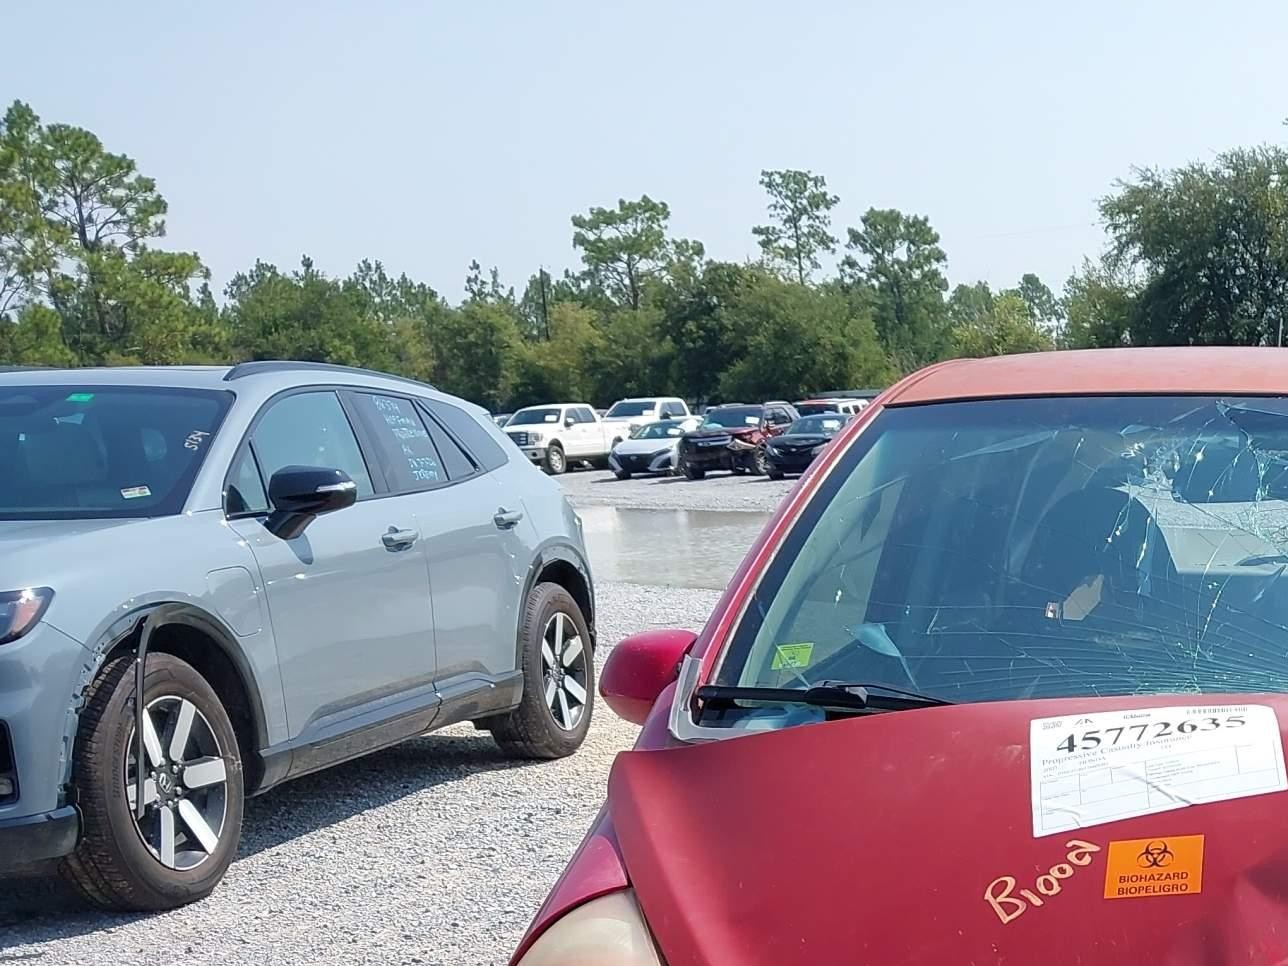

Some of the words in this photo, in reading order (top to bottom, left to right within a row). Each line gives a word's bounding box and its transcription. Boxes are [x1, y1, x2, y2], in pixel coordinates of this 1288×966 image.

[1056, 715, 1246, 753] 45772635
[1042, 750, 1098, 767] Progressive
[1100, 742, 1142, 755] Casualty
[1119, 871, 1189, 884] BIOHAZARD
[1117, 883, 1189, 896] BIOPELIGRO
